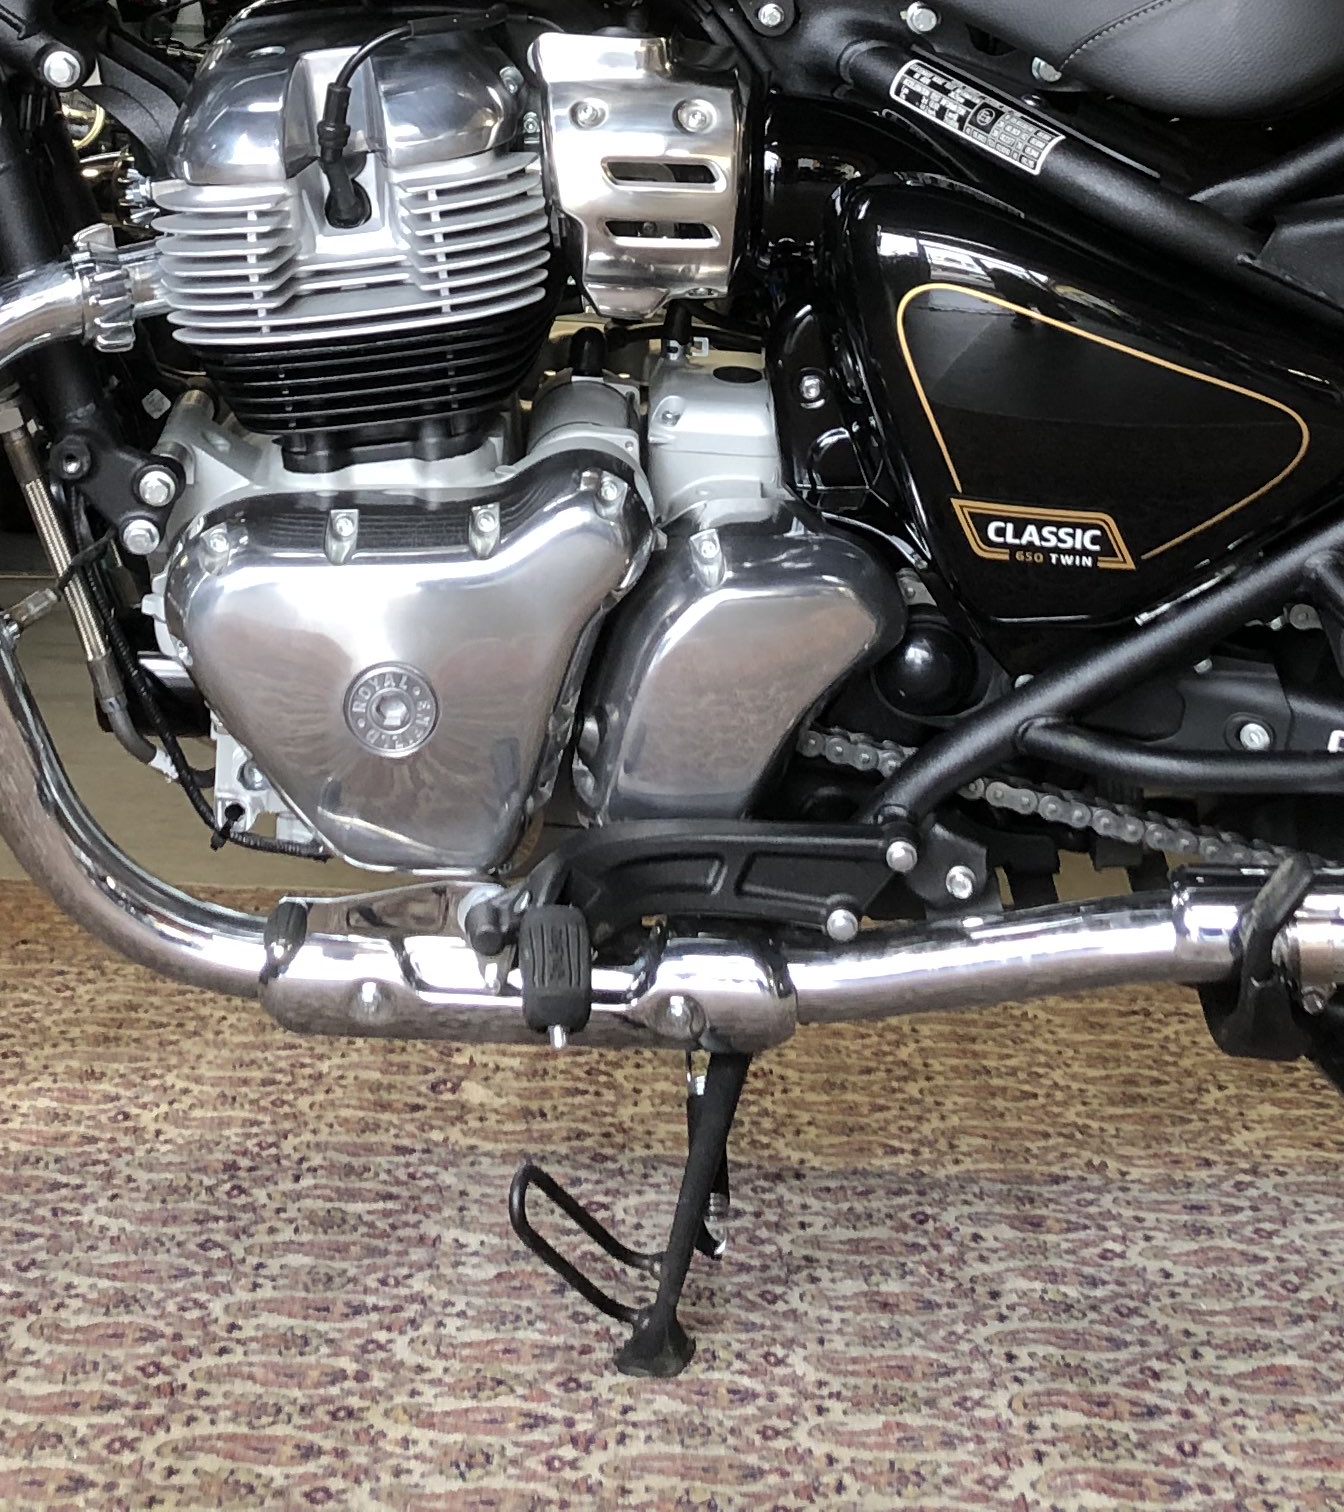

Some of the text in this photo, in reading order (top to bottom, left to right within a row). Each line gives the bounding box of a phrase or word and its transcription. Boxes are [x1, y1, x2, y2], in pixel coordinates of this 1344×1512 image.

[987, 520, 1102, 552] CLASSIC
[1015, 550, 1093, 568] 650 TWIN
[351, 673, 408, 713] ROYAL
